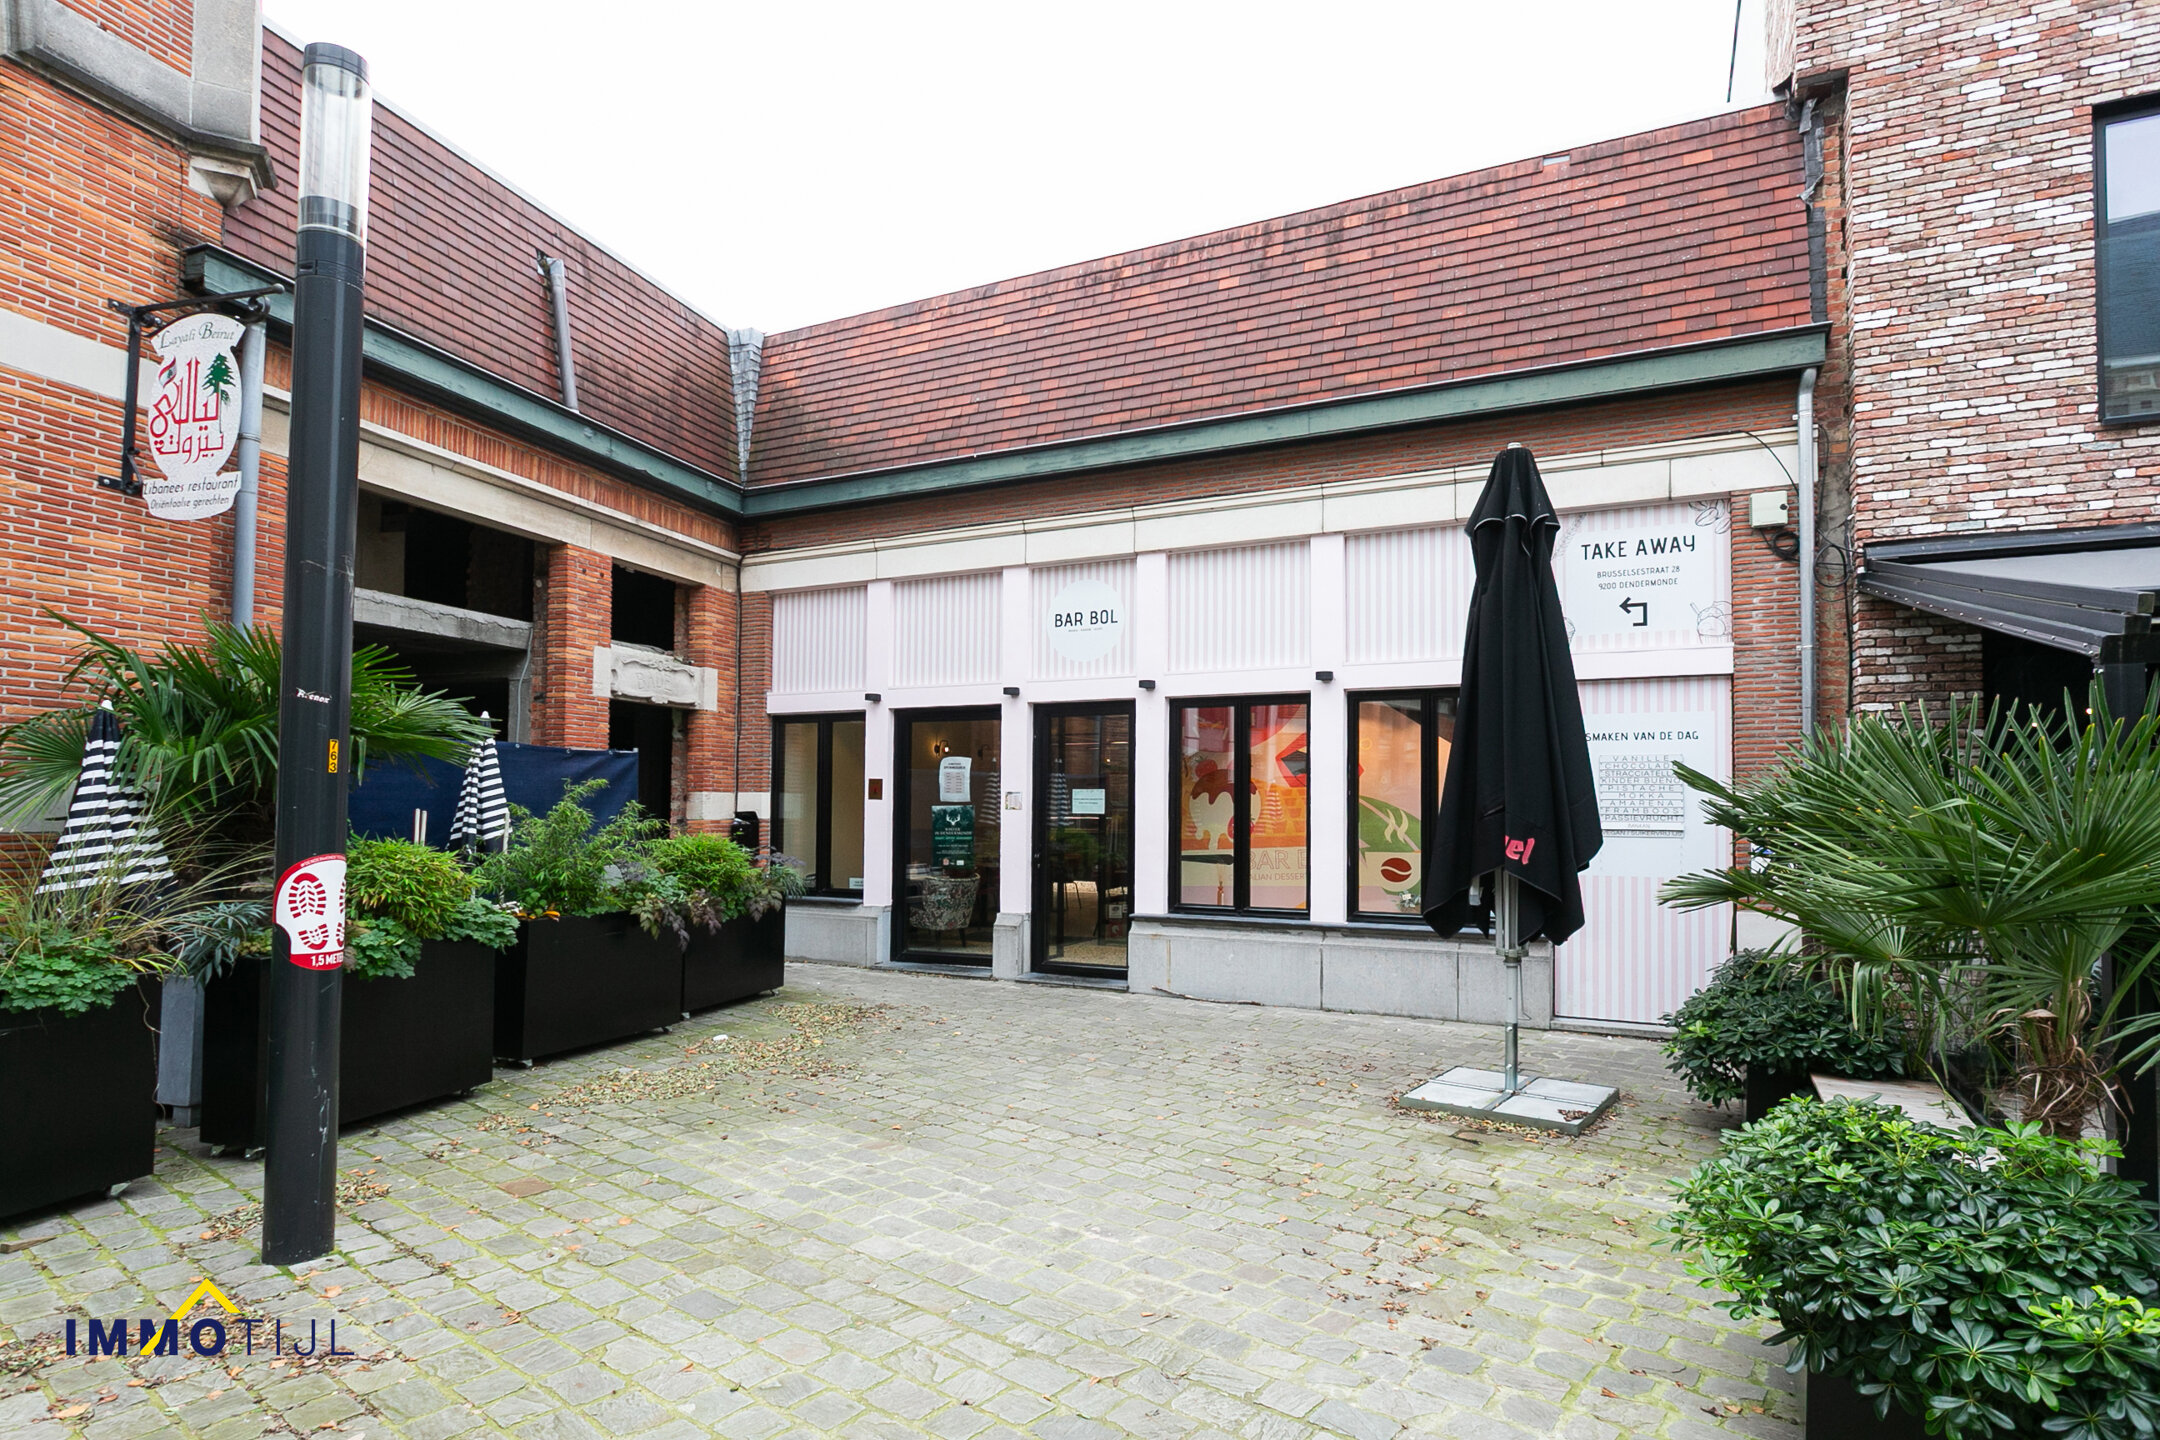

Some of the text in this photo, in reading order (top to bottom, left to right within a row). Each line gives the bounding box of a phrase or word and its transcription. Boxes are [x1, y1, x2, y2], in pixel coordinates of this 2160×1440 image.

[160, 322, 235, 349] Layali Beirut
[143, 474, 238, 495] Libanees restaurant
[193, 495, 229, 508] gerechten
[1581, 534, 1695, 560] TAKE AWAY
[1597, 565, 1680, 579] BRUSSELSESTRAAT 28
[1598, 577, 1678, 590] 9200 DENDERMONDE
[1054, 608, 1118, 628] BAR BOL
[1585, 730, 1699, 742] SMAKEN VAN DE DAG
[328, 739, 338, 772] 763
[1505, 835, 1535, 865] el
[1274, 872, 1305, 880] DESSER
